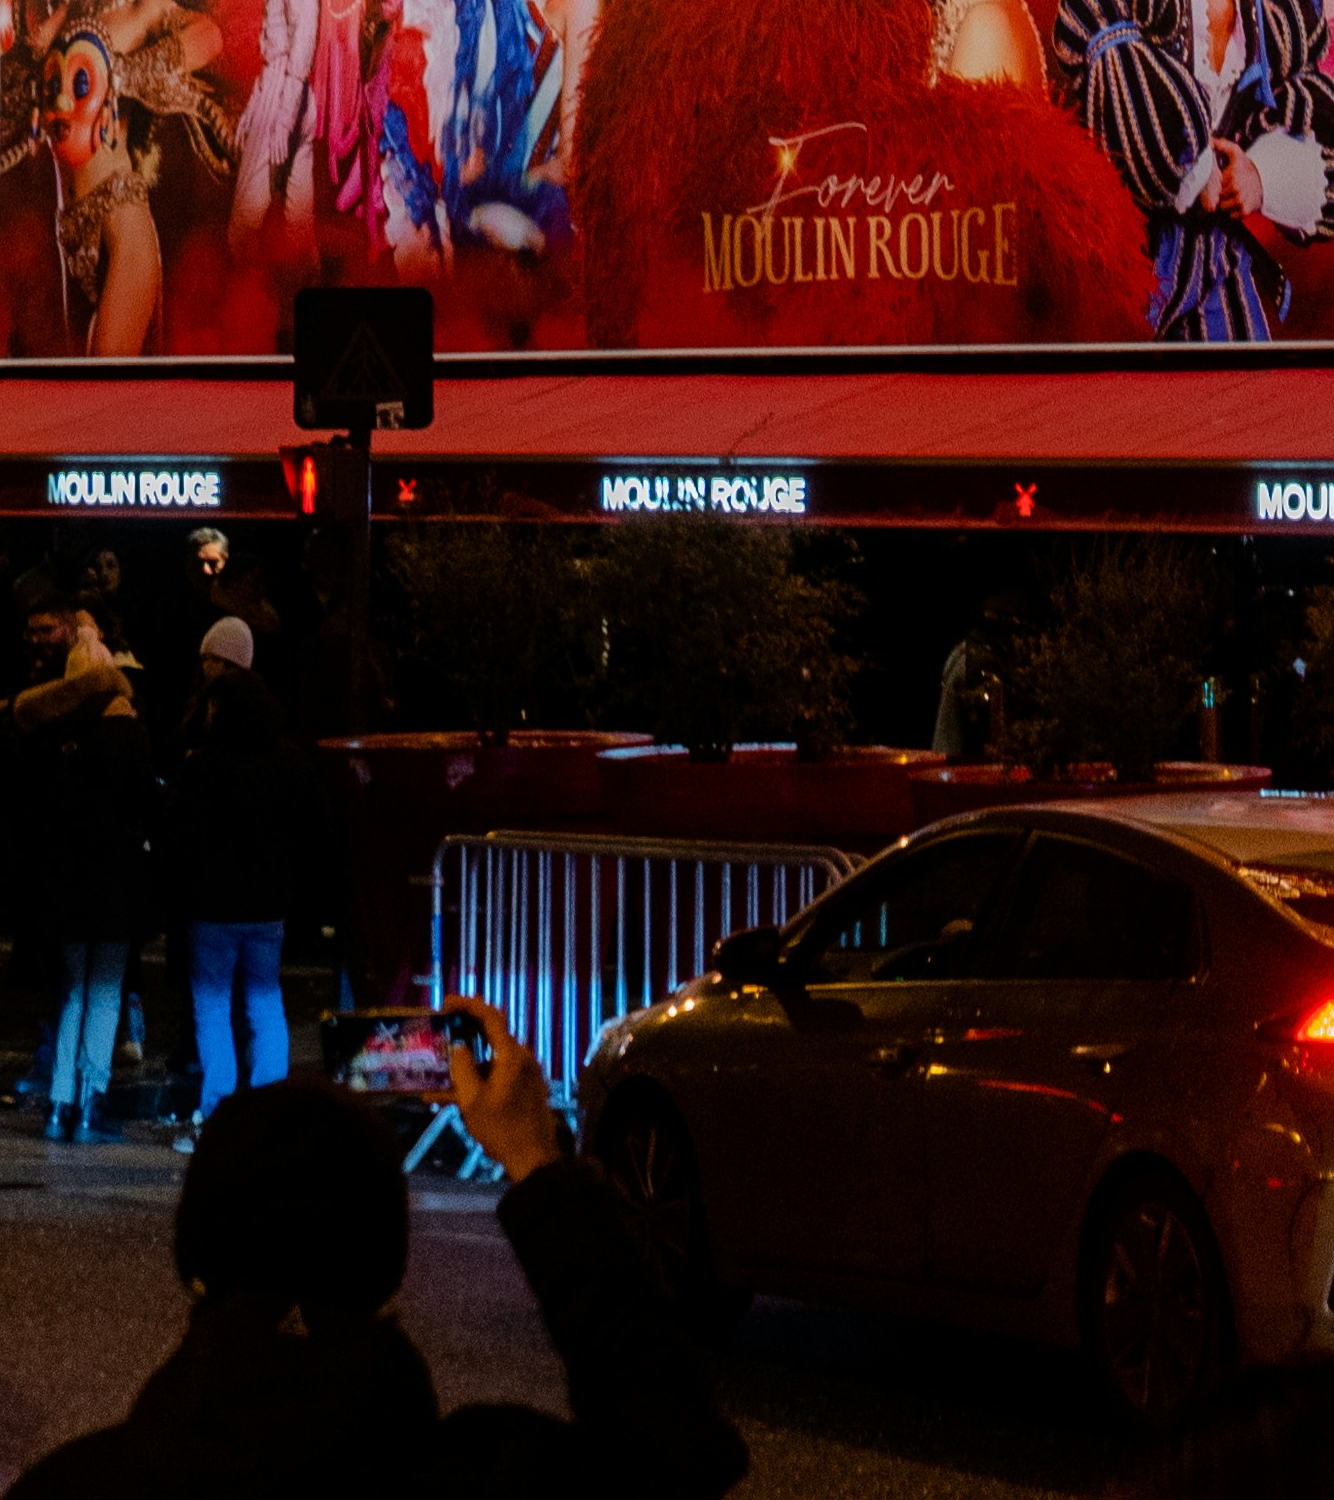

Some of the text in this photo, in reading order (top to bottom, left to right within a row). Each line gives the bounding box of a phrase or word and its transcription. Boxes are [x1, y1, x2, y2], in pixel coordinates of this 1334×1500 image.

[746, 121, 955, 226] Forever
[701, 210, 857, 294] MOULIN
[866, 202, 1017, 287] ROUGE
[47, 470, 221, 507] MOULIN ROUGE
[602, 474, 807, 514] MOULIN ROUGE
